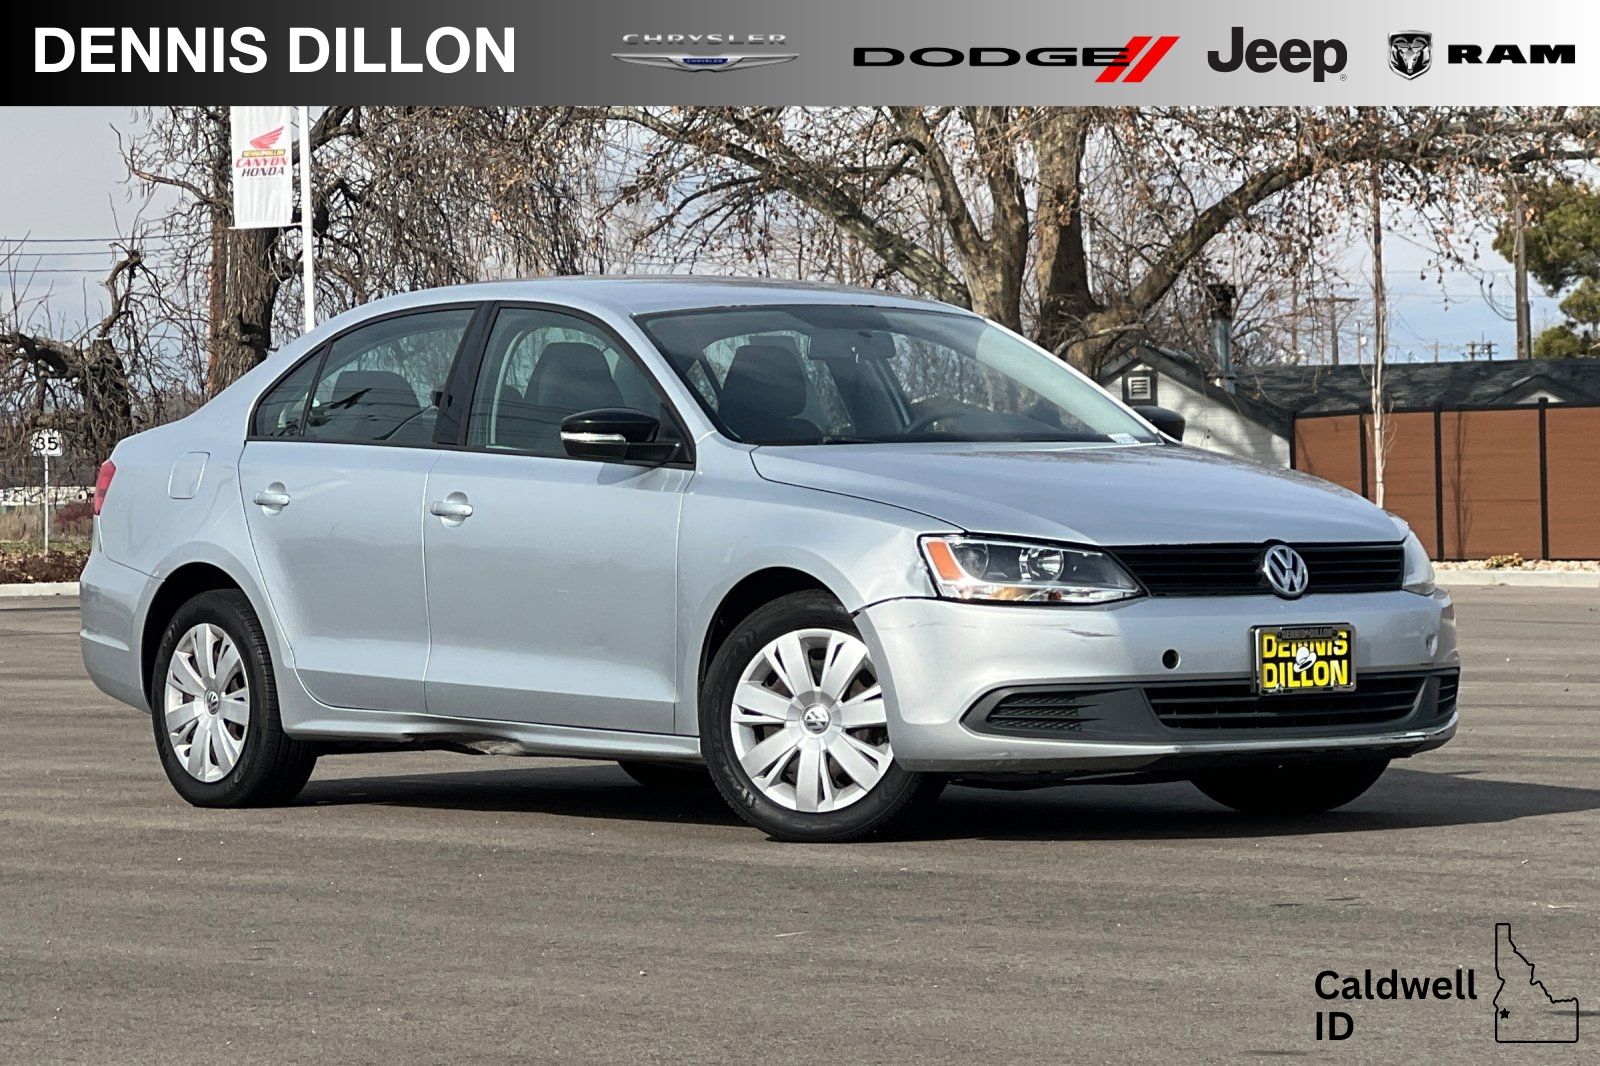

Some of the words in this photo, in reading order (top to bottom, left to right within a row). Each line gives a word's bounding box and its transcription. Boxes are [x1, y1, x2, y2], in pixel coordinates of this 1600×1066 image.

[236, 157, 288, 168] CANYON
[242, 167, 284, 177] HONDA
[35, 437, 58, 450] 35
[1262, 660, 1348, 688] DILLON
